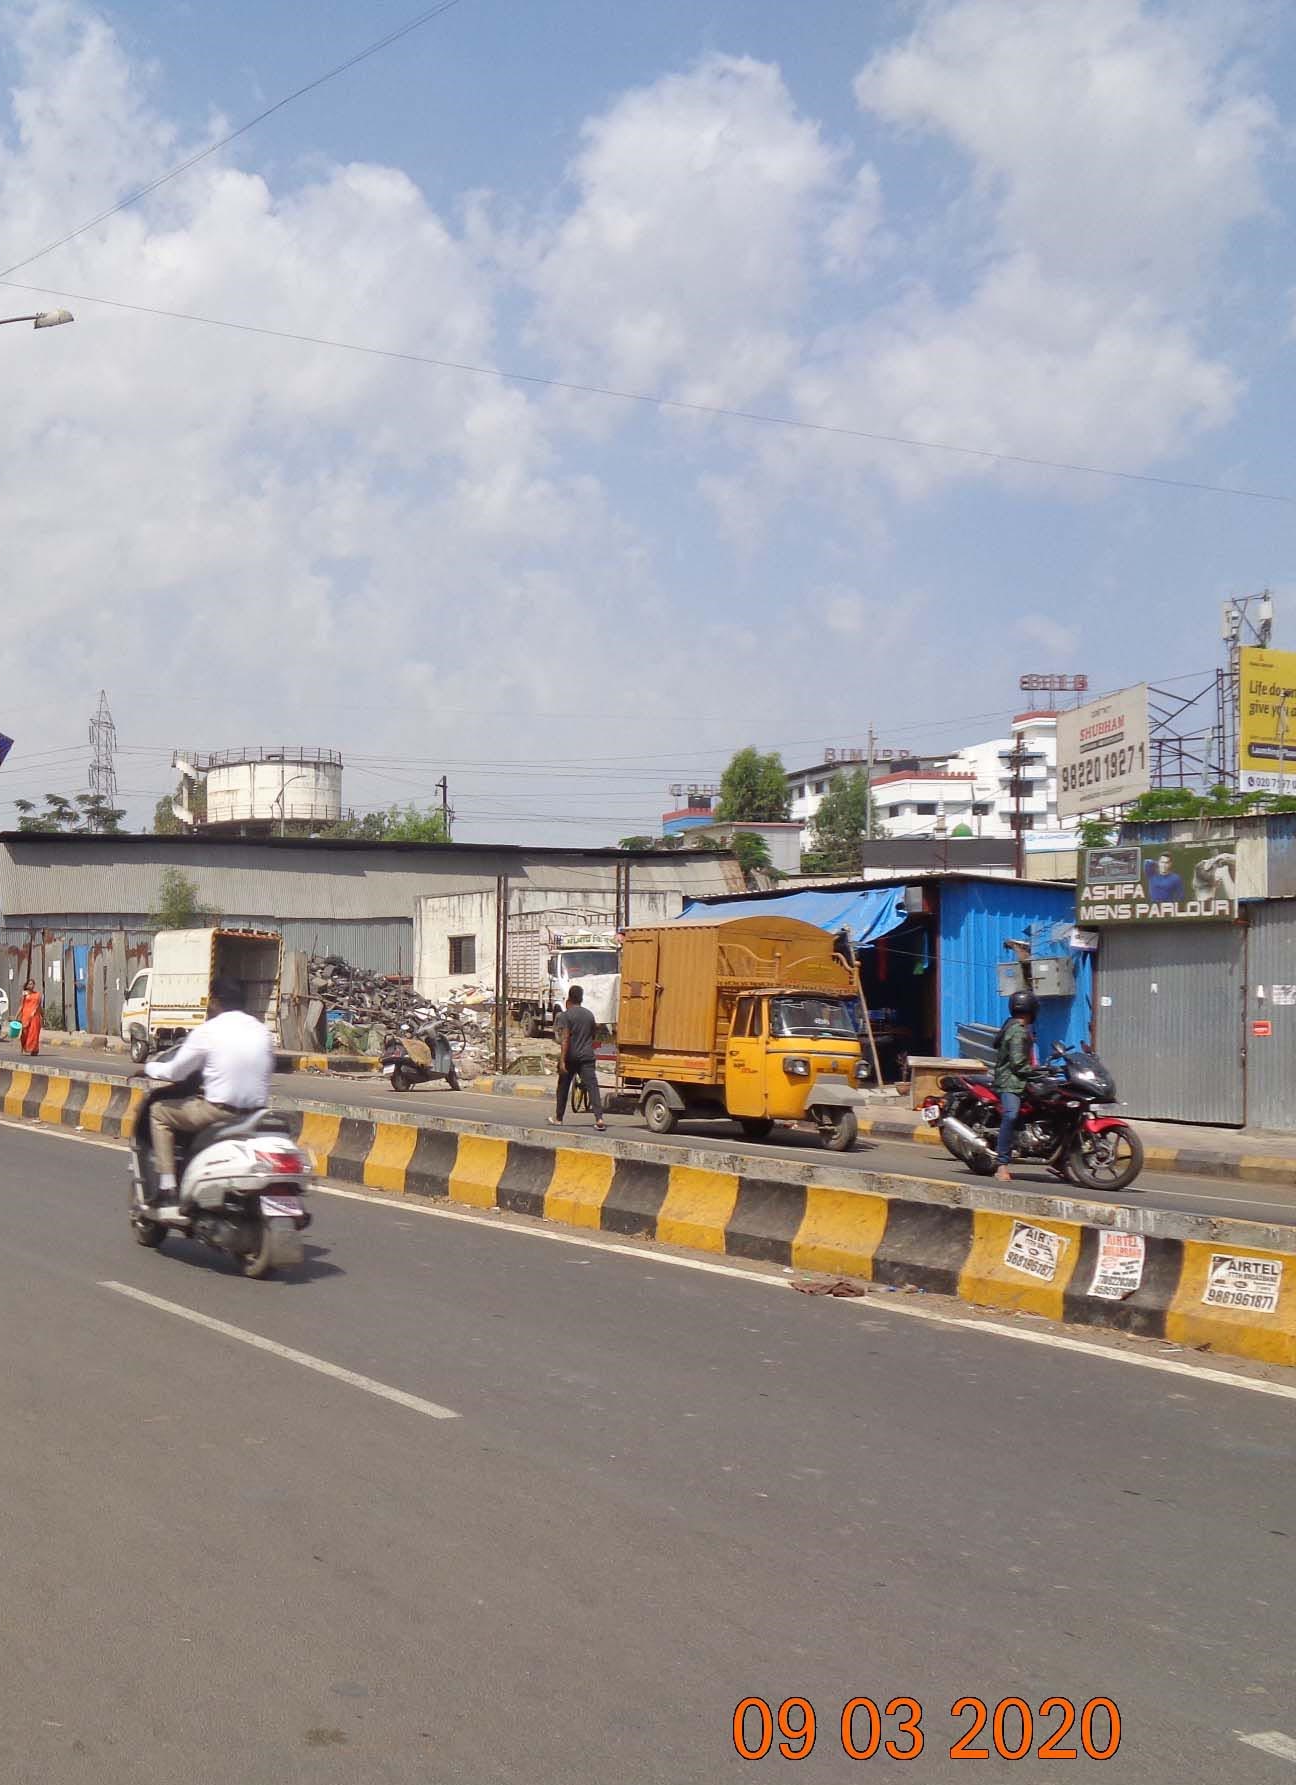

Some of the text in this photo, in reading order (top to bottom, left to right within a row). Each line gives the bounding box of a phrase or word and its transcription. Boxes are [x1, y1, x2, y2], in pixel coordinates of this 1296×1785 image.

[1249, 680, 1268, 696] Life
[1249, 700, 1270, 716] give
[1079, 714, 1126, 741] SHUBHAM
[1062, 756, 1101, 792] 98220
[1104, 741, 1145, 780] 19271
[1081, 883, 1145, 901] ASHIFA
[1080, 899, 1230, 921] MENS PARLOUR
[1227, 1260, 1280, 1276] AIRTEL
[1207, 1289, 1274, 1310] 9881961877
